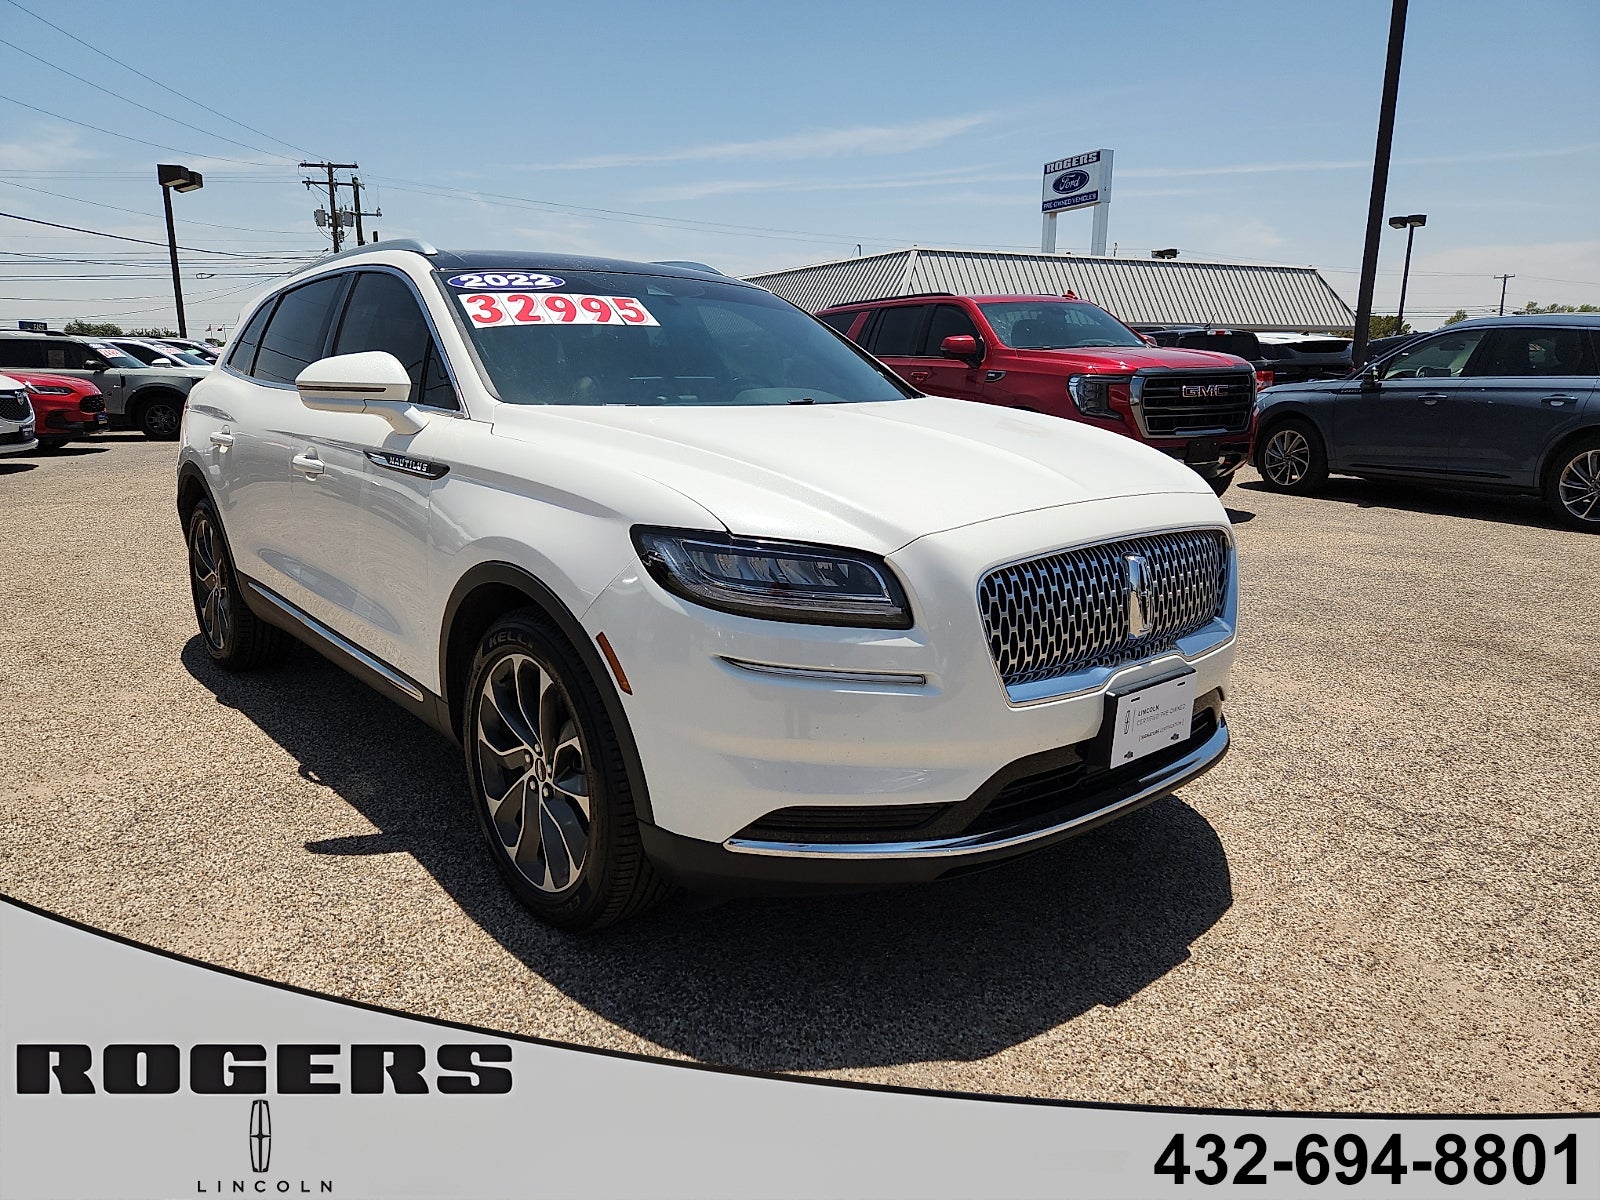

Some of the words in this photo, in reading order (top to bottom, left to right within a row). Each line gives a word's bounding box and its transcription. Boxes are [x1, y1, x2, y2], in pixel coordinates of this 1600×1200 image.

[1046, 152, 1098, 174] ROGERS
[1059, 173, 1081, 190] Ford
[459, 273, 558, 288] 2022
[466, 293, 649, 323] 32995
[1182, 384, 1229, 398] GMC
[389, 456, 429, 472] NAUTILUS
[1137, 704, 1160, 717] LINCOLN
